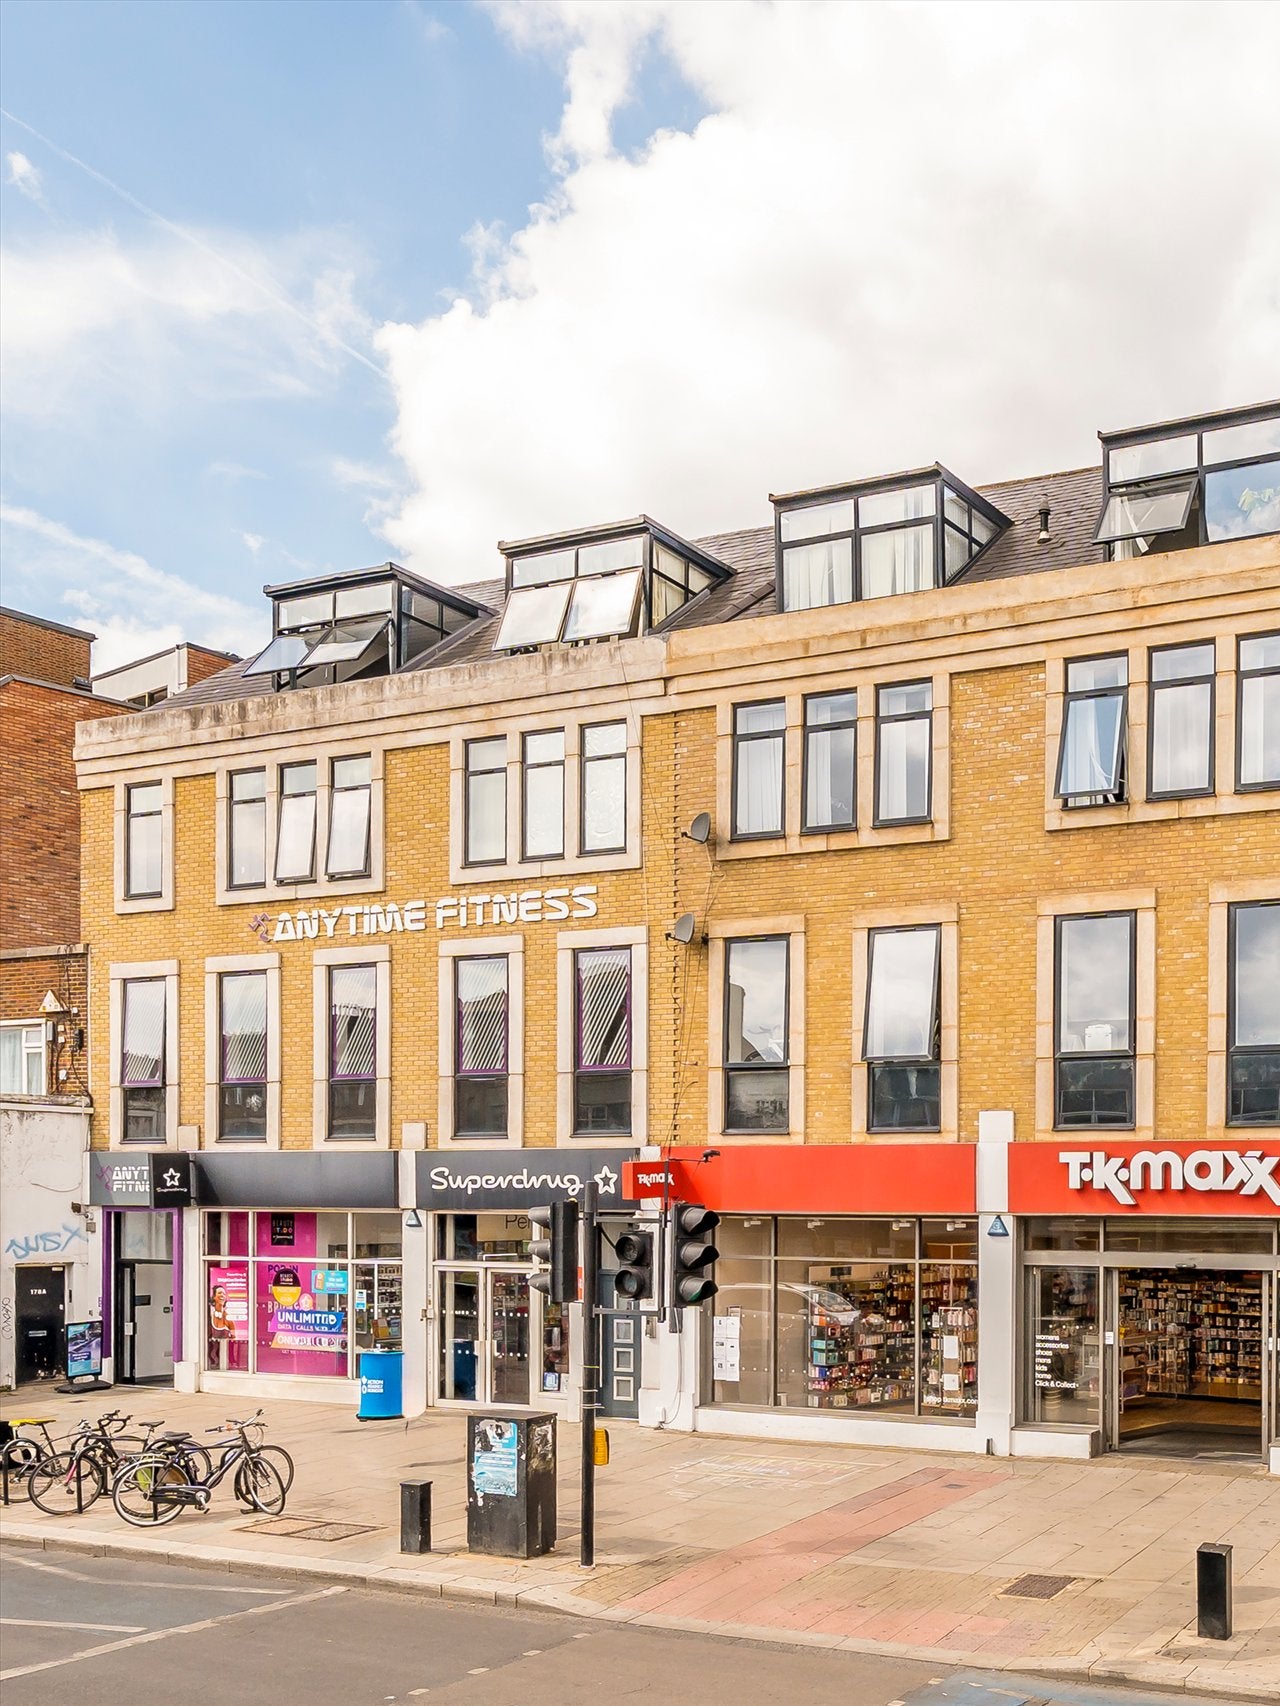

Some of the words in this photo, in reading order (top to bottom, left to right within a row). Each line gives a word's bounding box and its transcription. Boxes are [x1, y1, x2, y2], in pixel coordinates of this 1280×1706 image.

[273, 901, 426, 942] ANYTIME
[435, 886, 598, 929] FITNESS
[430, 1166, 584, 1196] Superdrug
[1035, 1379, 1050, 1387] Click
